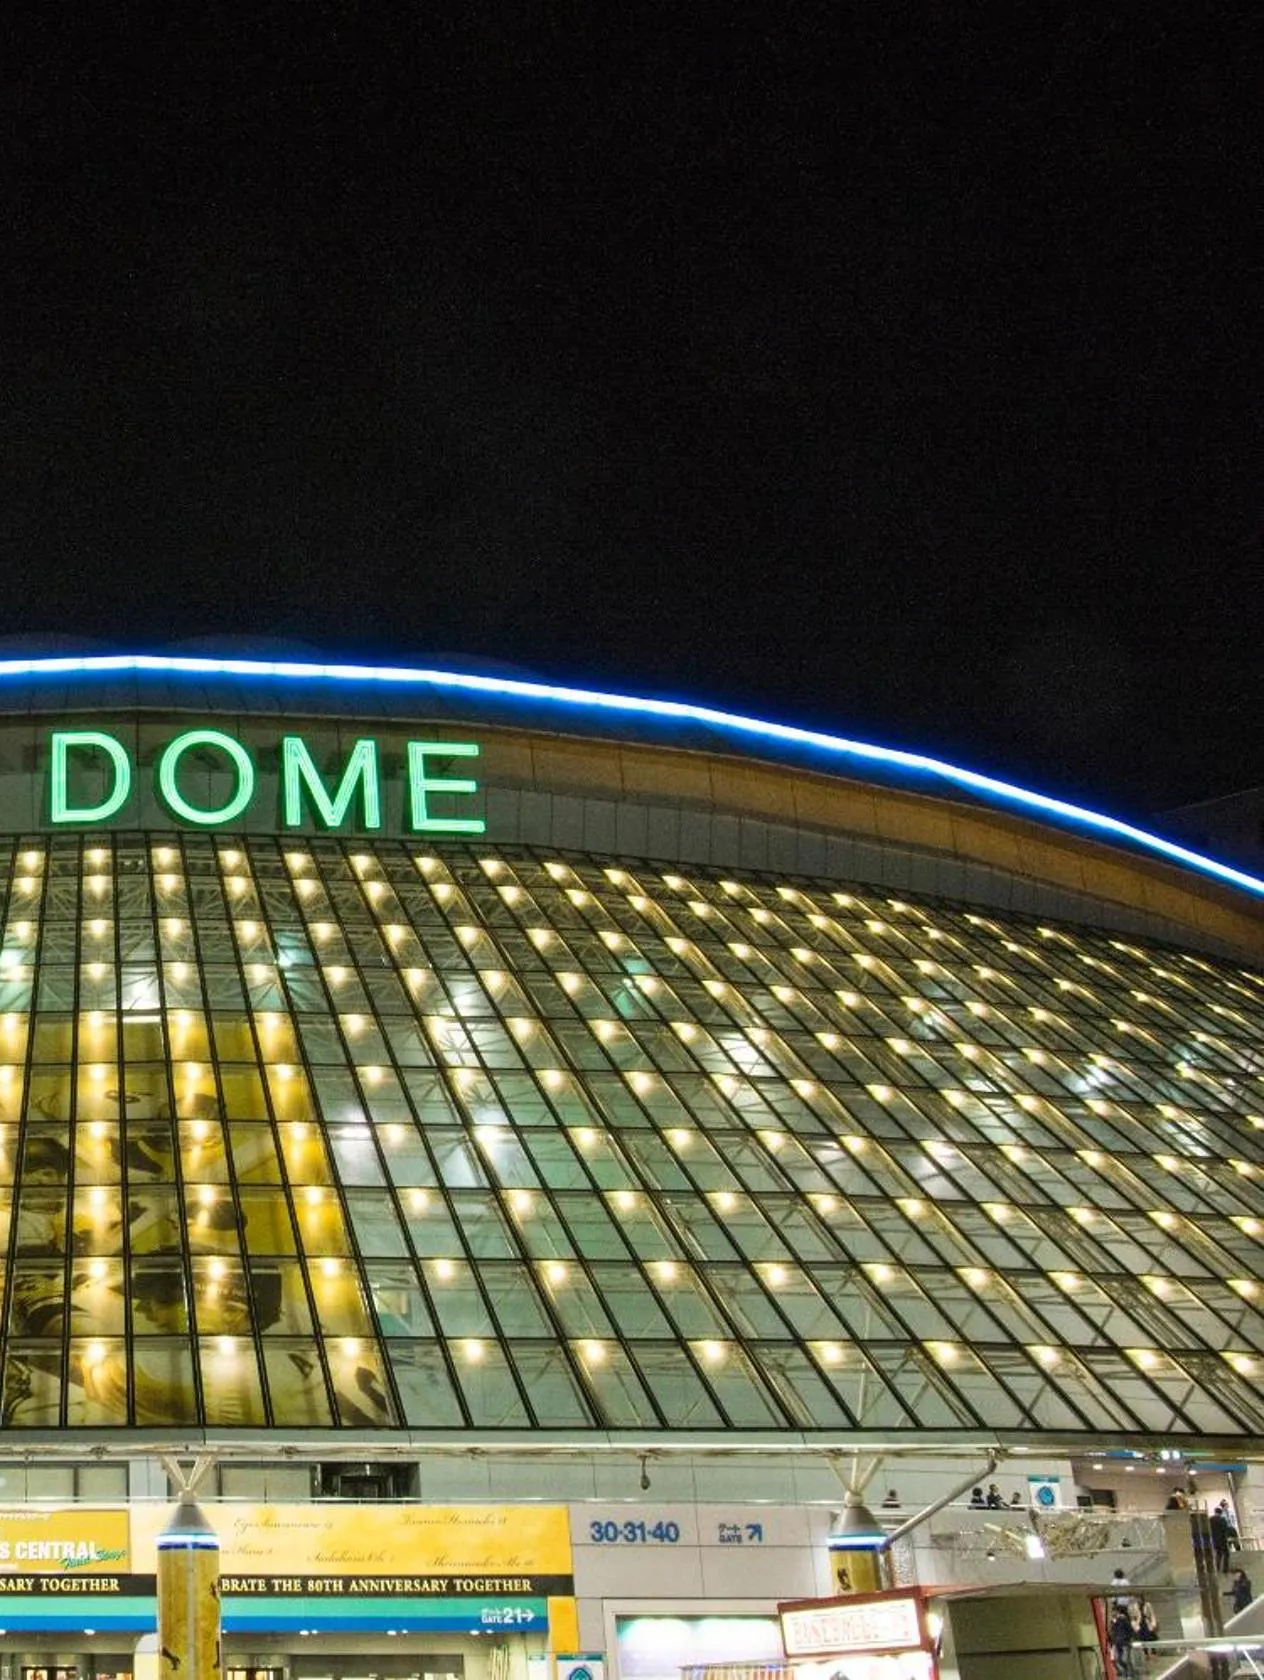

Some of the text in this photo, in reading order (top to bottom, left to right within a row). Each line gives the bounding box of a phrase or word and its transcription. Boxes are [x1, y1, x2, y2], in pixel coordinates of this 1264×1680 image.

[51, 730, 486, 834] DOME
[14, 1541, 97, 1560] CENTRAL
[40, 1577, 120, 1592] TOGETHER
[219, 1578, 533, 1592] BRATE THE 80TH ANNIVERSARY TOGETHER
[481, 1615, 503, 1624] GATE
[503, 1607, 522, 1624] 21
